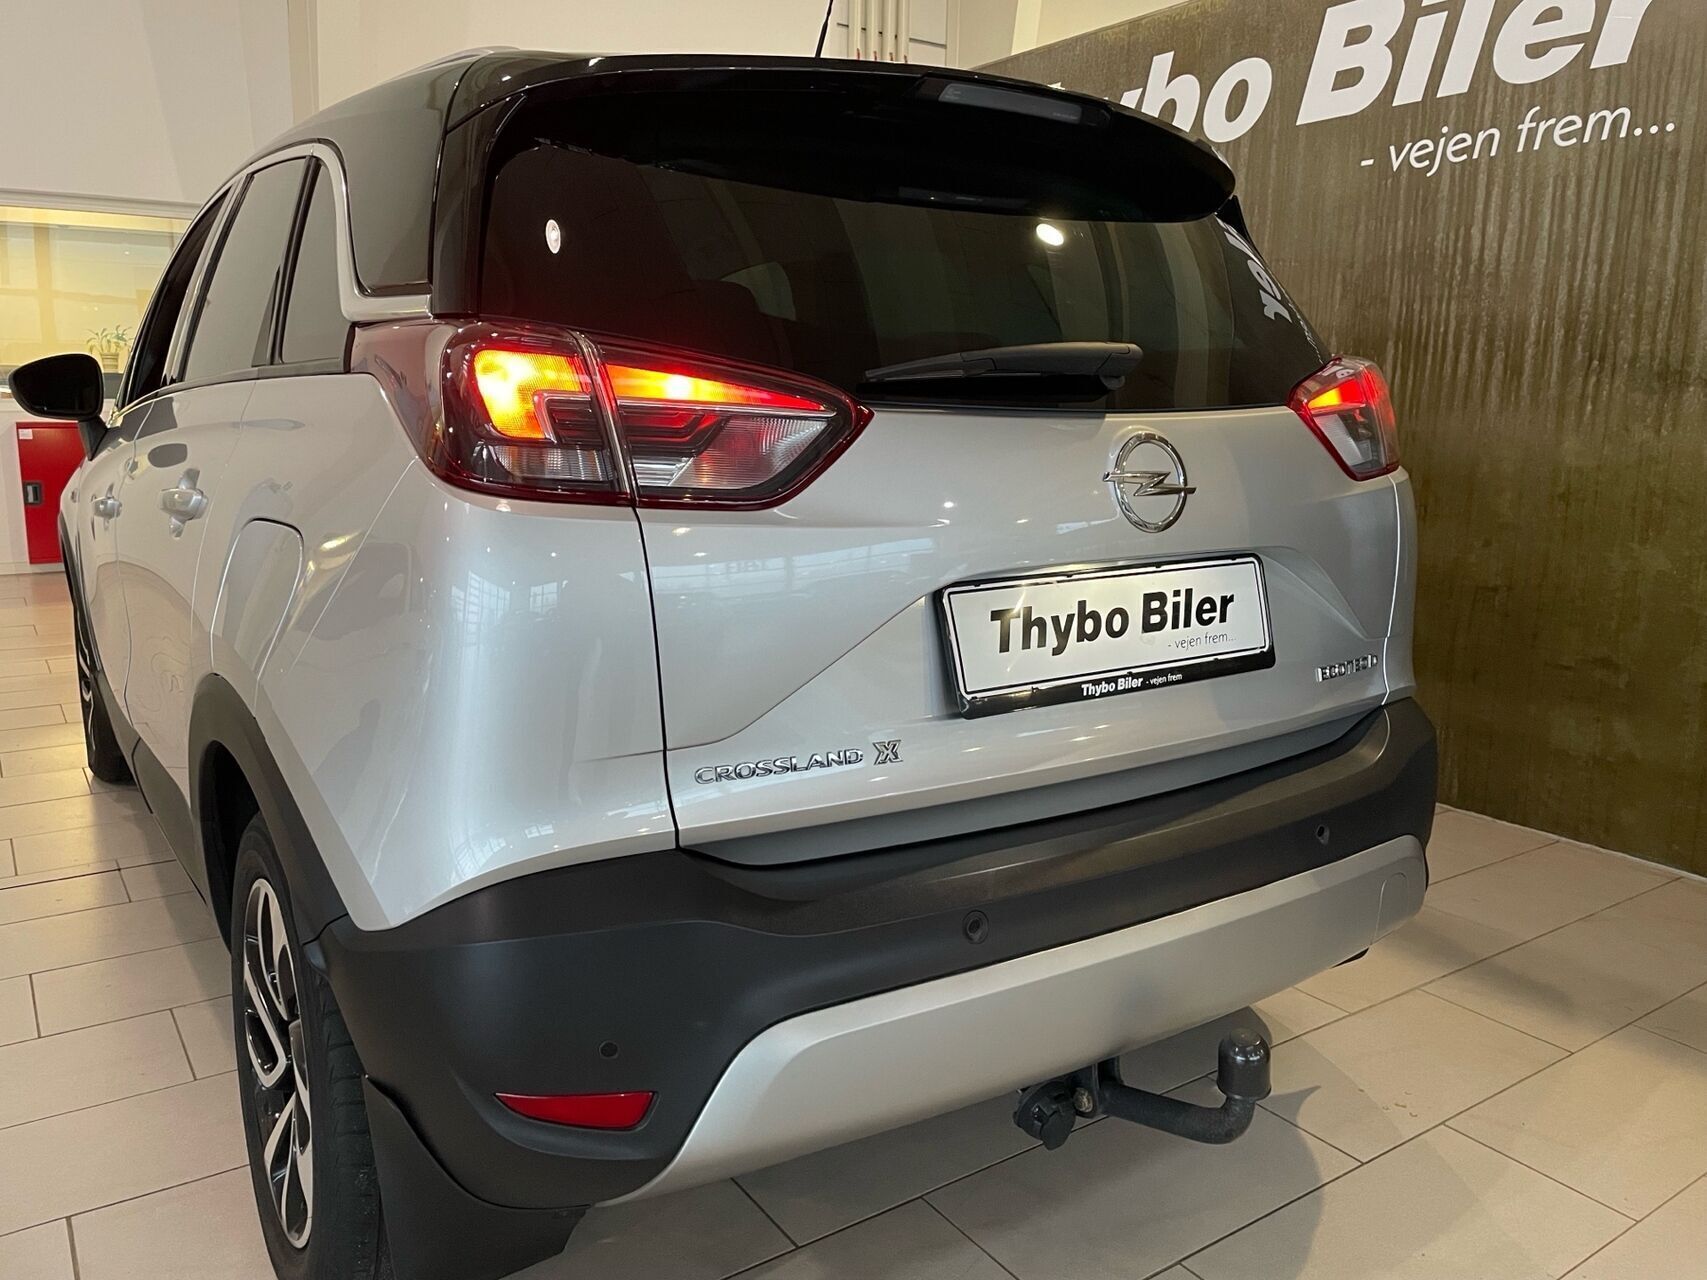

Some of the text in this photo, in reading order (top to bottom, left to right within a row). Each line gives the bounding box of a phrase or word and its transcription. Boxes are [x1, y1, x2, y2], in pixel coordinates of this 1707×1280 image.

[1296, 0, 1653, 126] Biler
[1389, 125, 1501, 177] vejen
[1516, 105, 1676, 153] frem...
[990, 587, 1235, 656] Thybo Biler
[1174, 635, 1202, 651] vejen
[1081, 682, 1115, 696] Thybo
[1117, 677, 1143, 690] Biler
[1150, 676, 1166, 686] vejen
[694, 739, 904, 785] CROSSLAND X
